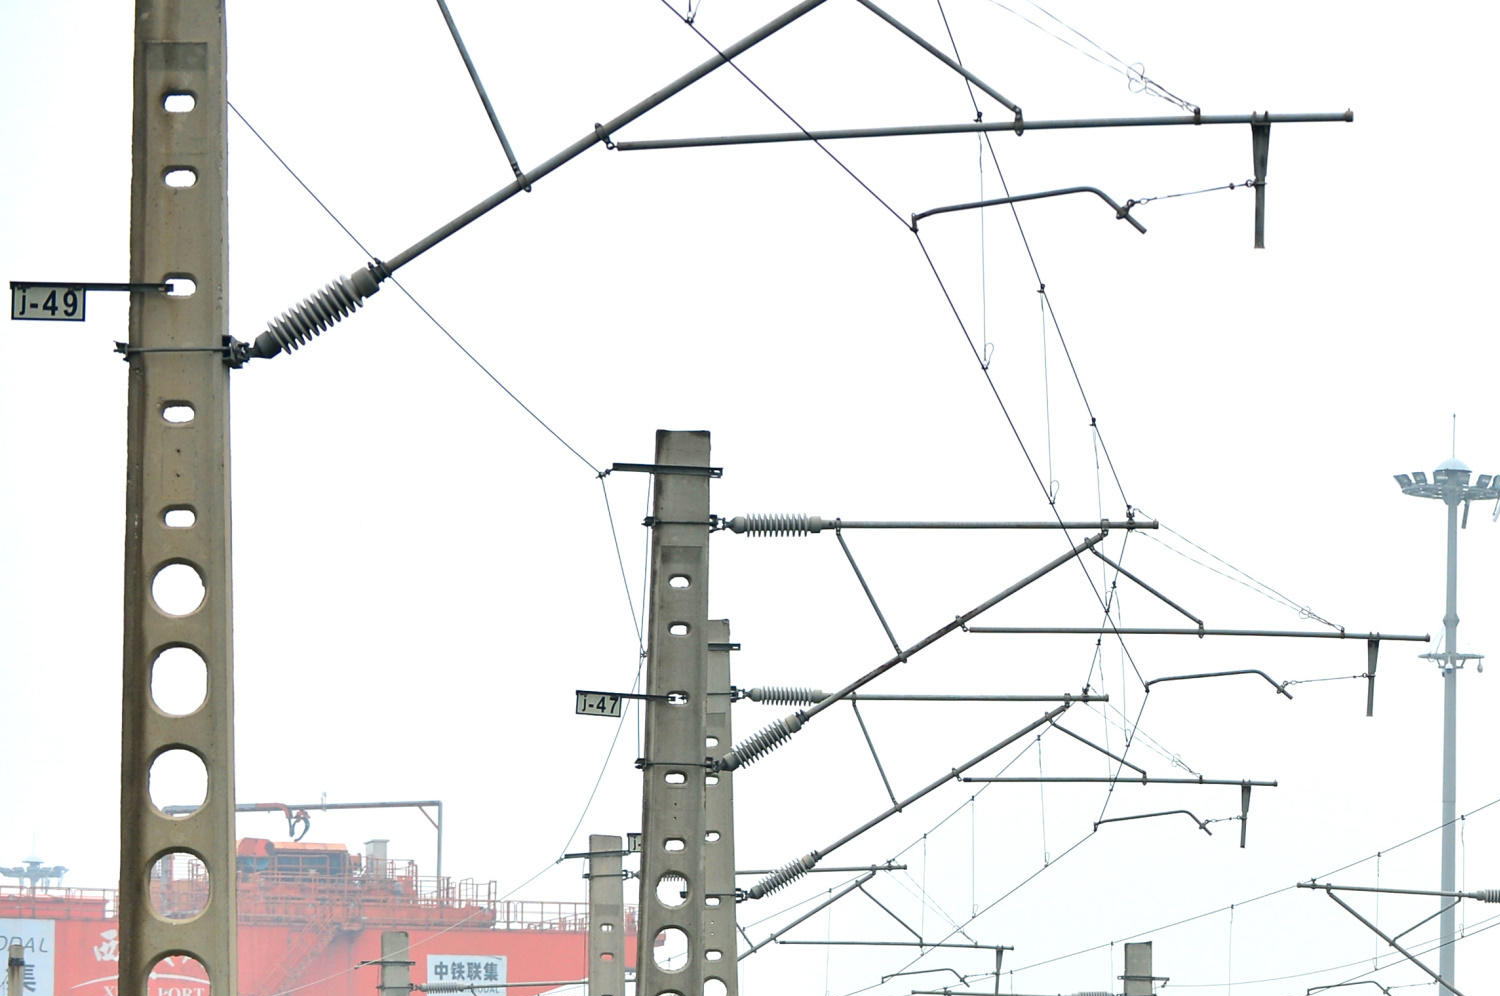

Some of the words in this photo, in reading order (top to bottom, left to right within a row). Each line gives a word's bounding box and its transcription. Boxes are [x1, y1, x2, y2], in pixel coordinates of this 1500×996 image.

[19, 288, 78, 317] j-49
[582, 694, 619, 714] j-47
[434, 961, 499, 981] 中铁联集
